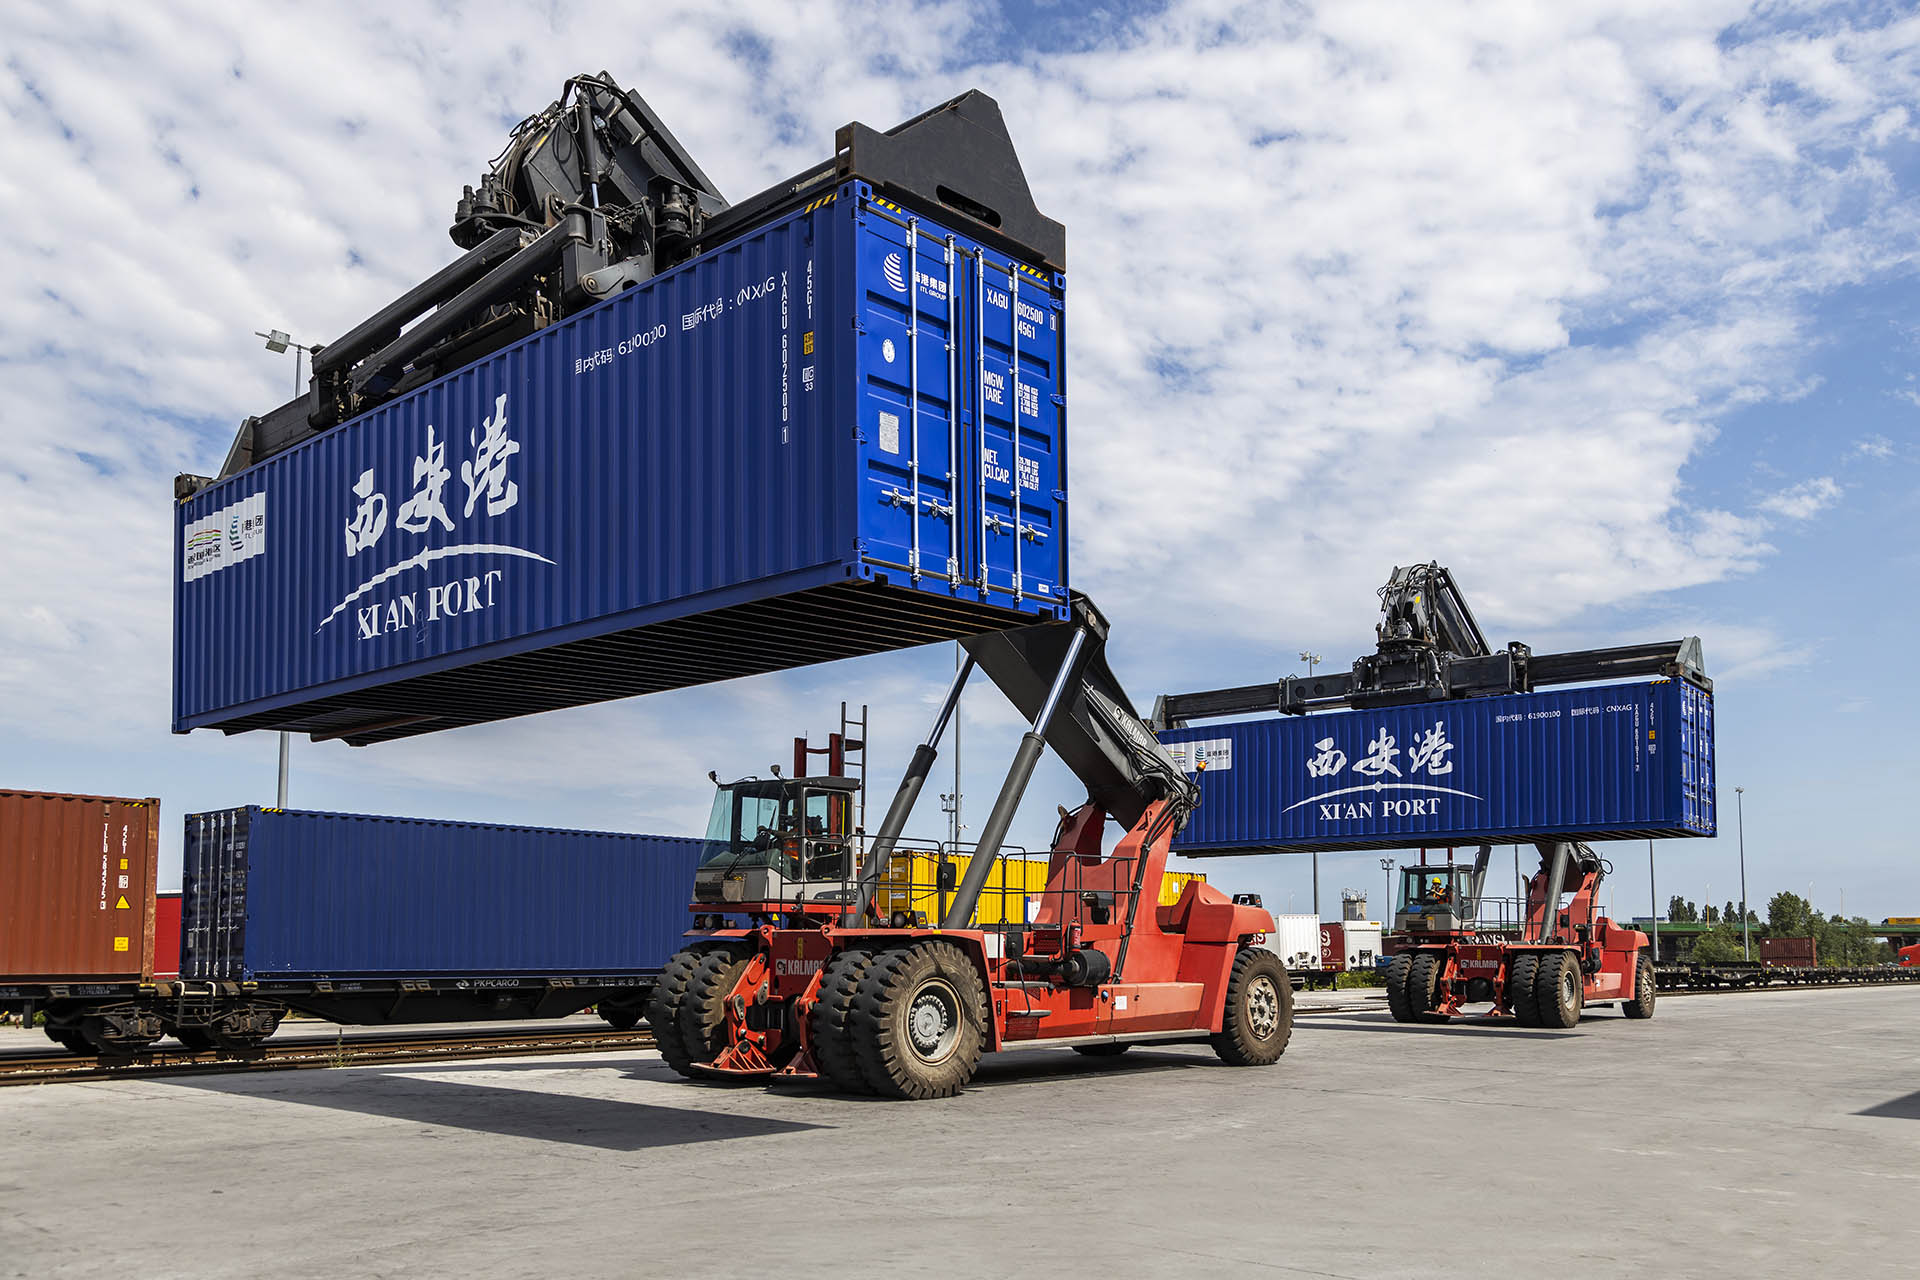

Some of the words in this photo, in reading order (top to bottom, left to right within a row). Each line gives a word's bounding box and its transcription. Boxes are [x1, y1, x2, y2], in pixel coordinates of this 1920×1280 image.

[986, 288, 1009, 310] XAGU
[1017, 301, 1044, 325] 602500
[1050, 314, 1056, 331] 1
[1018, 320, 1036, 340] 45G1
[781, 426, 789, 444] 1
[345, 393, 520, 557] 西安港
[427, 570, 502, 622] PORT
[1527, 710, 1561, 720] 61900100
[1606, 704, 1632, 712] CNXAG
[1306, 720, 1454, 778] 西安港
[1320, 801, 1373, 820] XI'AN
[1382, 798, 1441, 818] PORT
